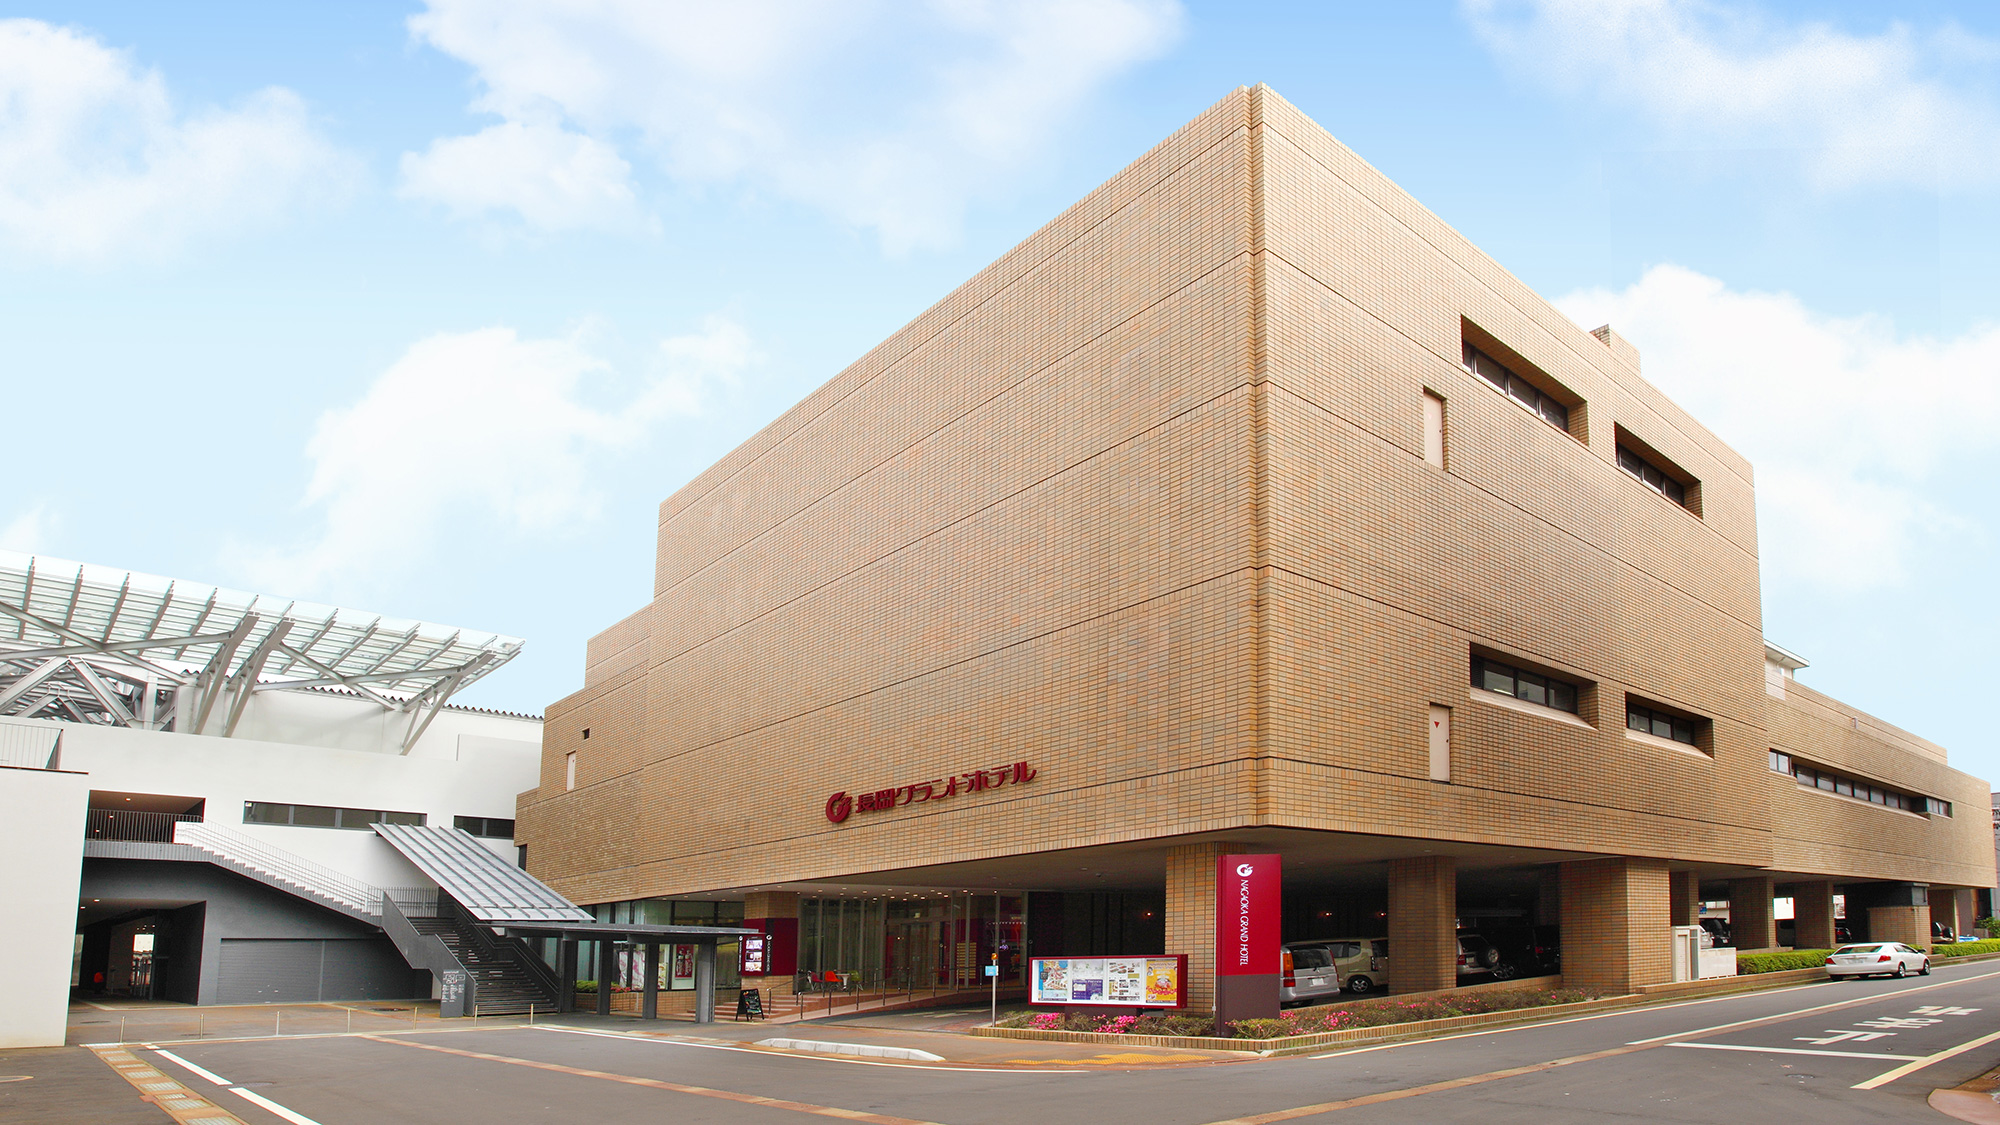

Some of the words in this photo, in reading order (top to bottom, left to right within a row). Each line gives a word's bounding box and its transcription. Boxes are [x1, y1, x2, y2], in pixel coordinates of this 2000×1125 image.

[855, 761, 1037, 813] 長岡グランドホテル
[1240, 879, 1249, 915] NAGAOKA
[1240, 916, 1249, 942] GRAND
[1240, 944, 1249, 966] HOTEL
[1793, 1005, 1982, 1045] 止まれ
